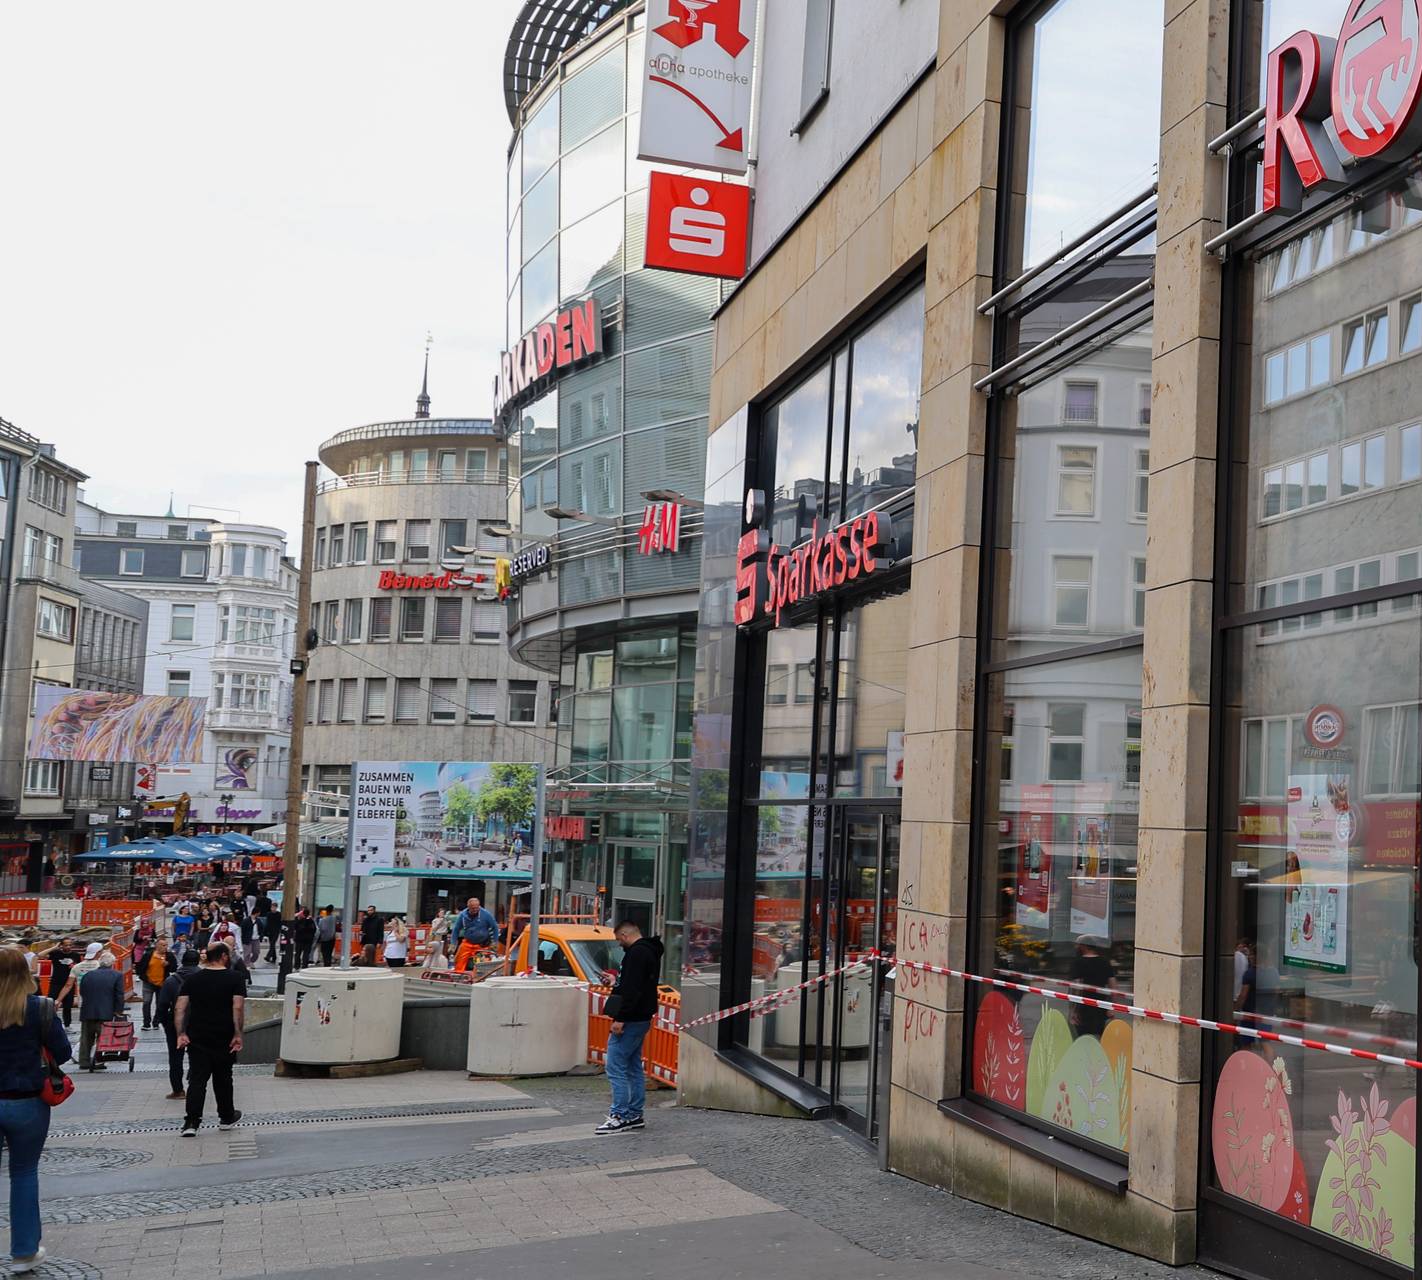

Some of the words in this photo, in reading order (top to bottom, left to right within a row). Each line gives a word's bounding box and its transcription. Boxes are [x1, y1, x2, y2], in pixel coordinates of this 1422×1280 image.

[648, 57, 685, 74] alpha
[689, 65, 749, 85] apotheke
[492, 297, 602, 427] ARKADEN
[637, 501, 681, 556] H&M
[509, 546, 548, 577] RESERVED
[764, 511, 882, 628] Sparkasse
[358, 772, 415, 783] ZUSAMMEN
[358, 784, 391, 794] BAUEN
[393, 785, 411, 795] WIR
[357, 797, 376, 806] DAS
[378, 797, 404, 807] NEUE
[215, 806, 262, 820] Pieper
[357, 809, 407, 820] ELBERFELD
